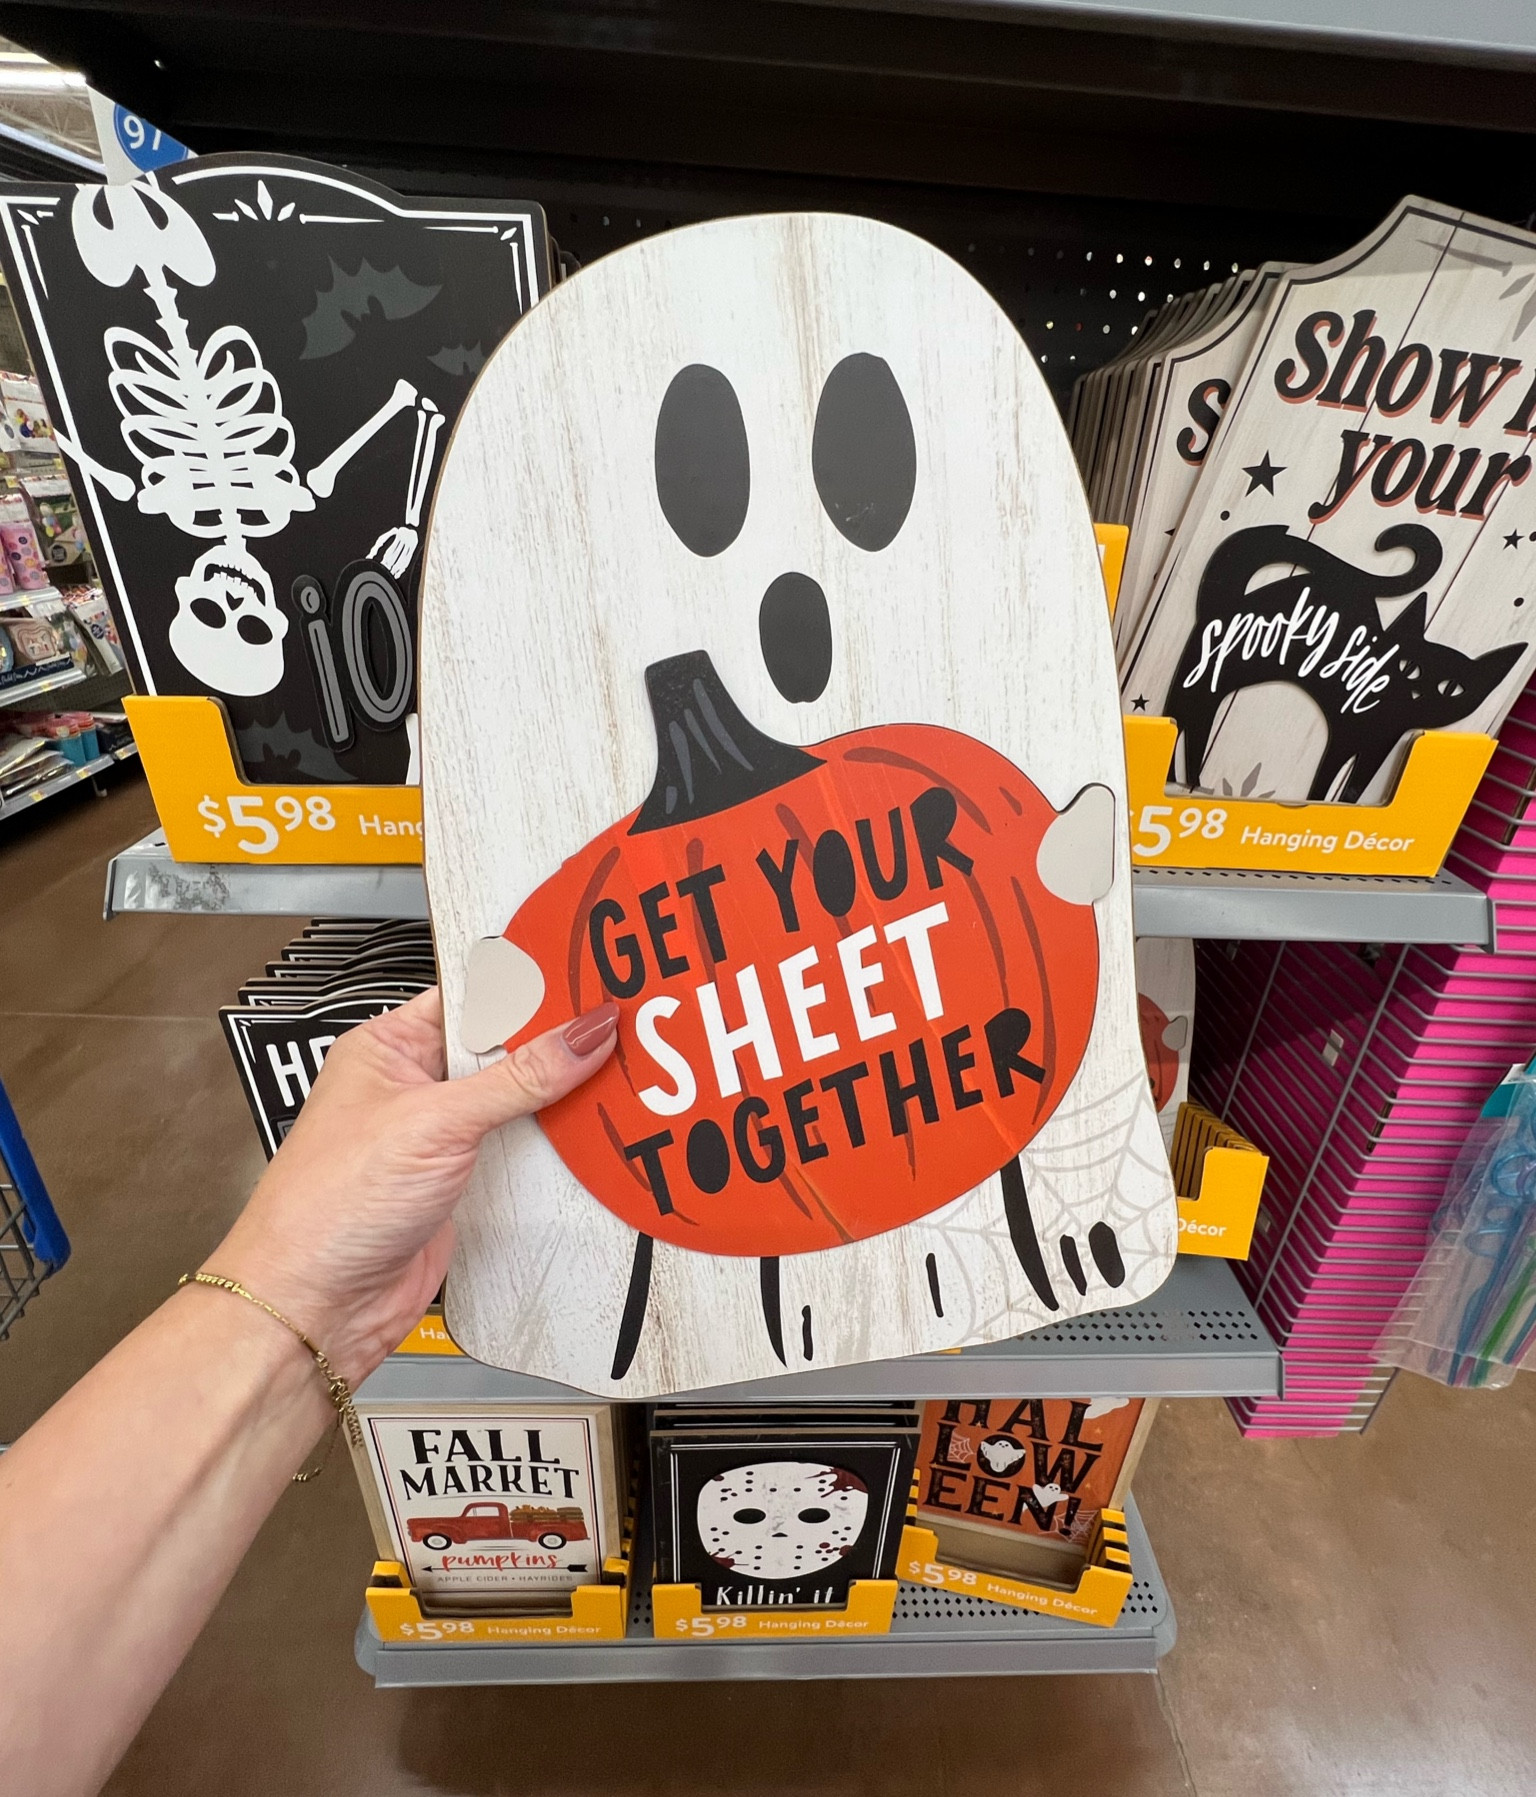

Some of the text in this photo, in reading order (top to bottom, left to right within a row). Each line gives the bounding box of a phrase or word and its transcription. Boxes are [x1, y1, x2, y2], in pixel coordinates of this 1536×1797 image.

[1274, 309, 1523, 428] Show
[1308, 429, 1532, 524] your
[1183, 586, 1400, 714] spooky side
[1240, 825, 1338, 854] Hanging
[1343, 830, 1415, 852] Décor
[588, 787, 974, 999] GET YOUR
[635, 902, 949, 1116] SHEET
[624, 1008, 1045, 1215] TOGETHER
[407, 1429, 561, 1465] FALL
[929, 1421, 1102, 1494] LOW
[399, 1464, 580, 1501] MARKET
[437, 1575, 471, 1583] APPLE
[441, 1551, 558, 1572] pumpkins
[986, 1582, 1048, 1607] Hanging
[1052, 1597, 1099, 1616] Décor
[486, 1624, 552, 1636] Hanging
[556, 1624, 602, 1635] Décor
[758, 1619, 821, 1631] Hanging
[825, 1618, 869, 1630] Décor
